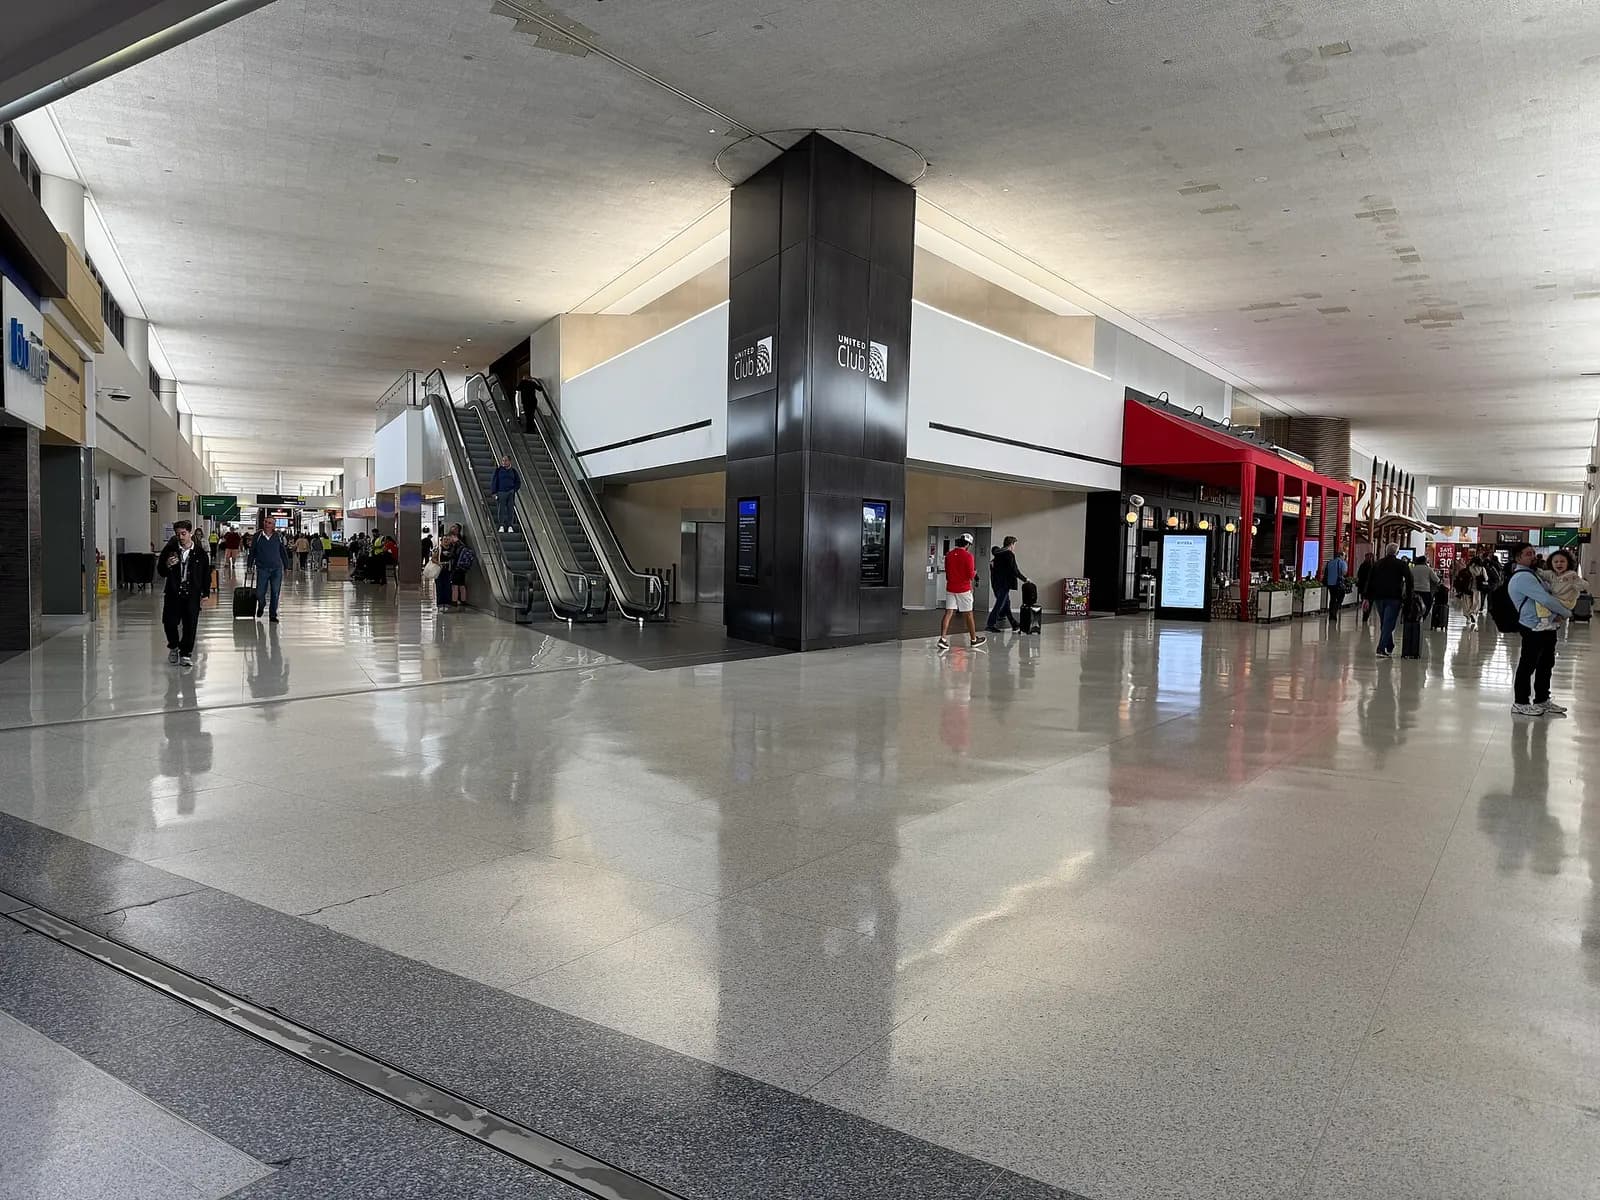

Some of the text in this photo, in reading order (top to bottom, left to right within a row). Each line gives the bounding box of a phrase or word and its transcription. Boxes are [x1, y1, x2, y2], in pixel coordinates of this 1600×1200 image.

[838, 334, 866, 350] UNITED
[734, 346, 755, 360] UNITED
[837, 345, 866, 373] Club
[734, 355, 754, 381] Club
